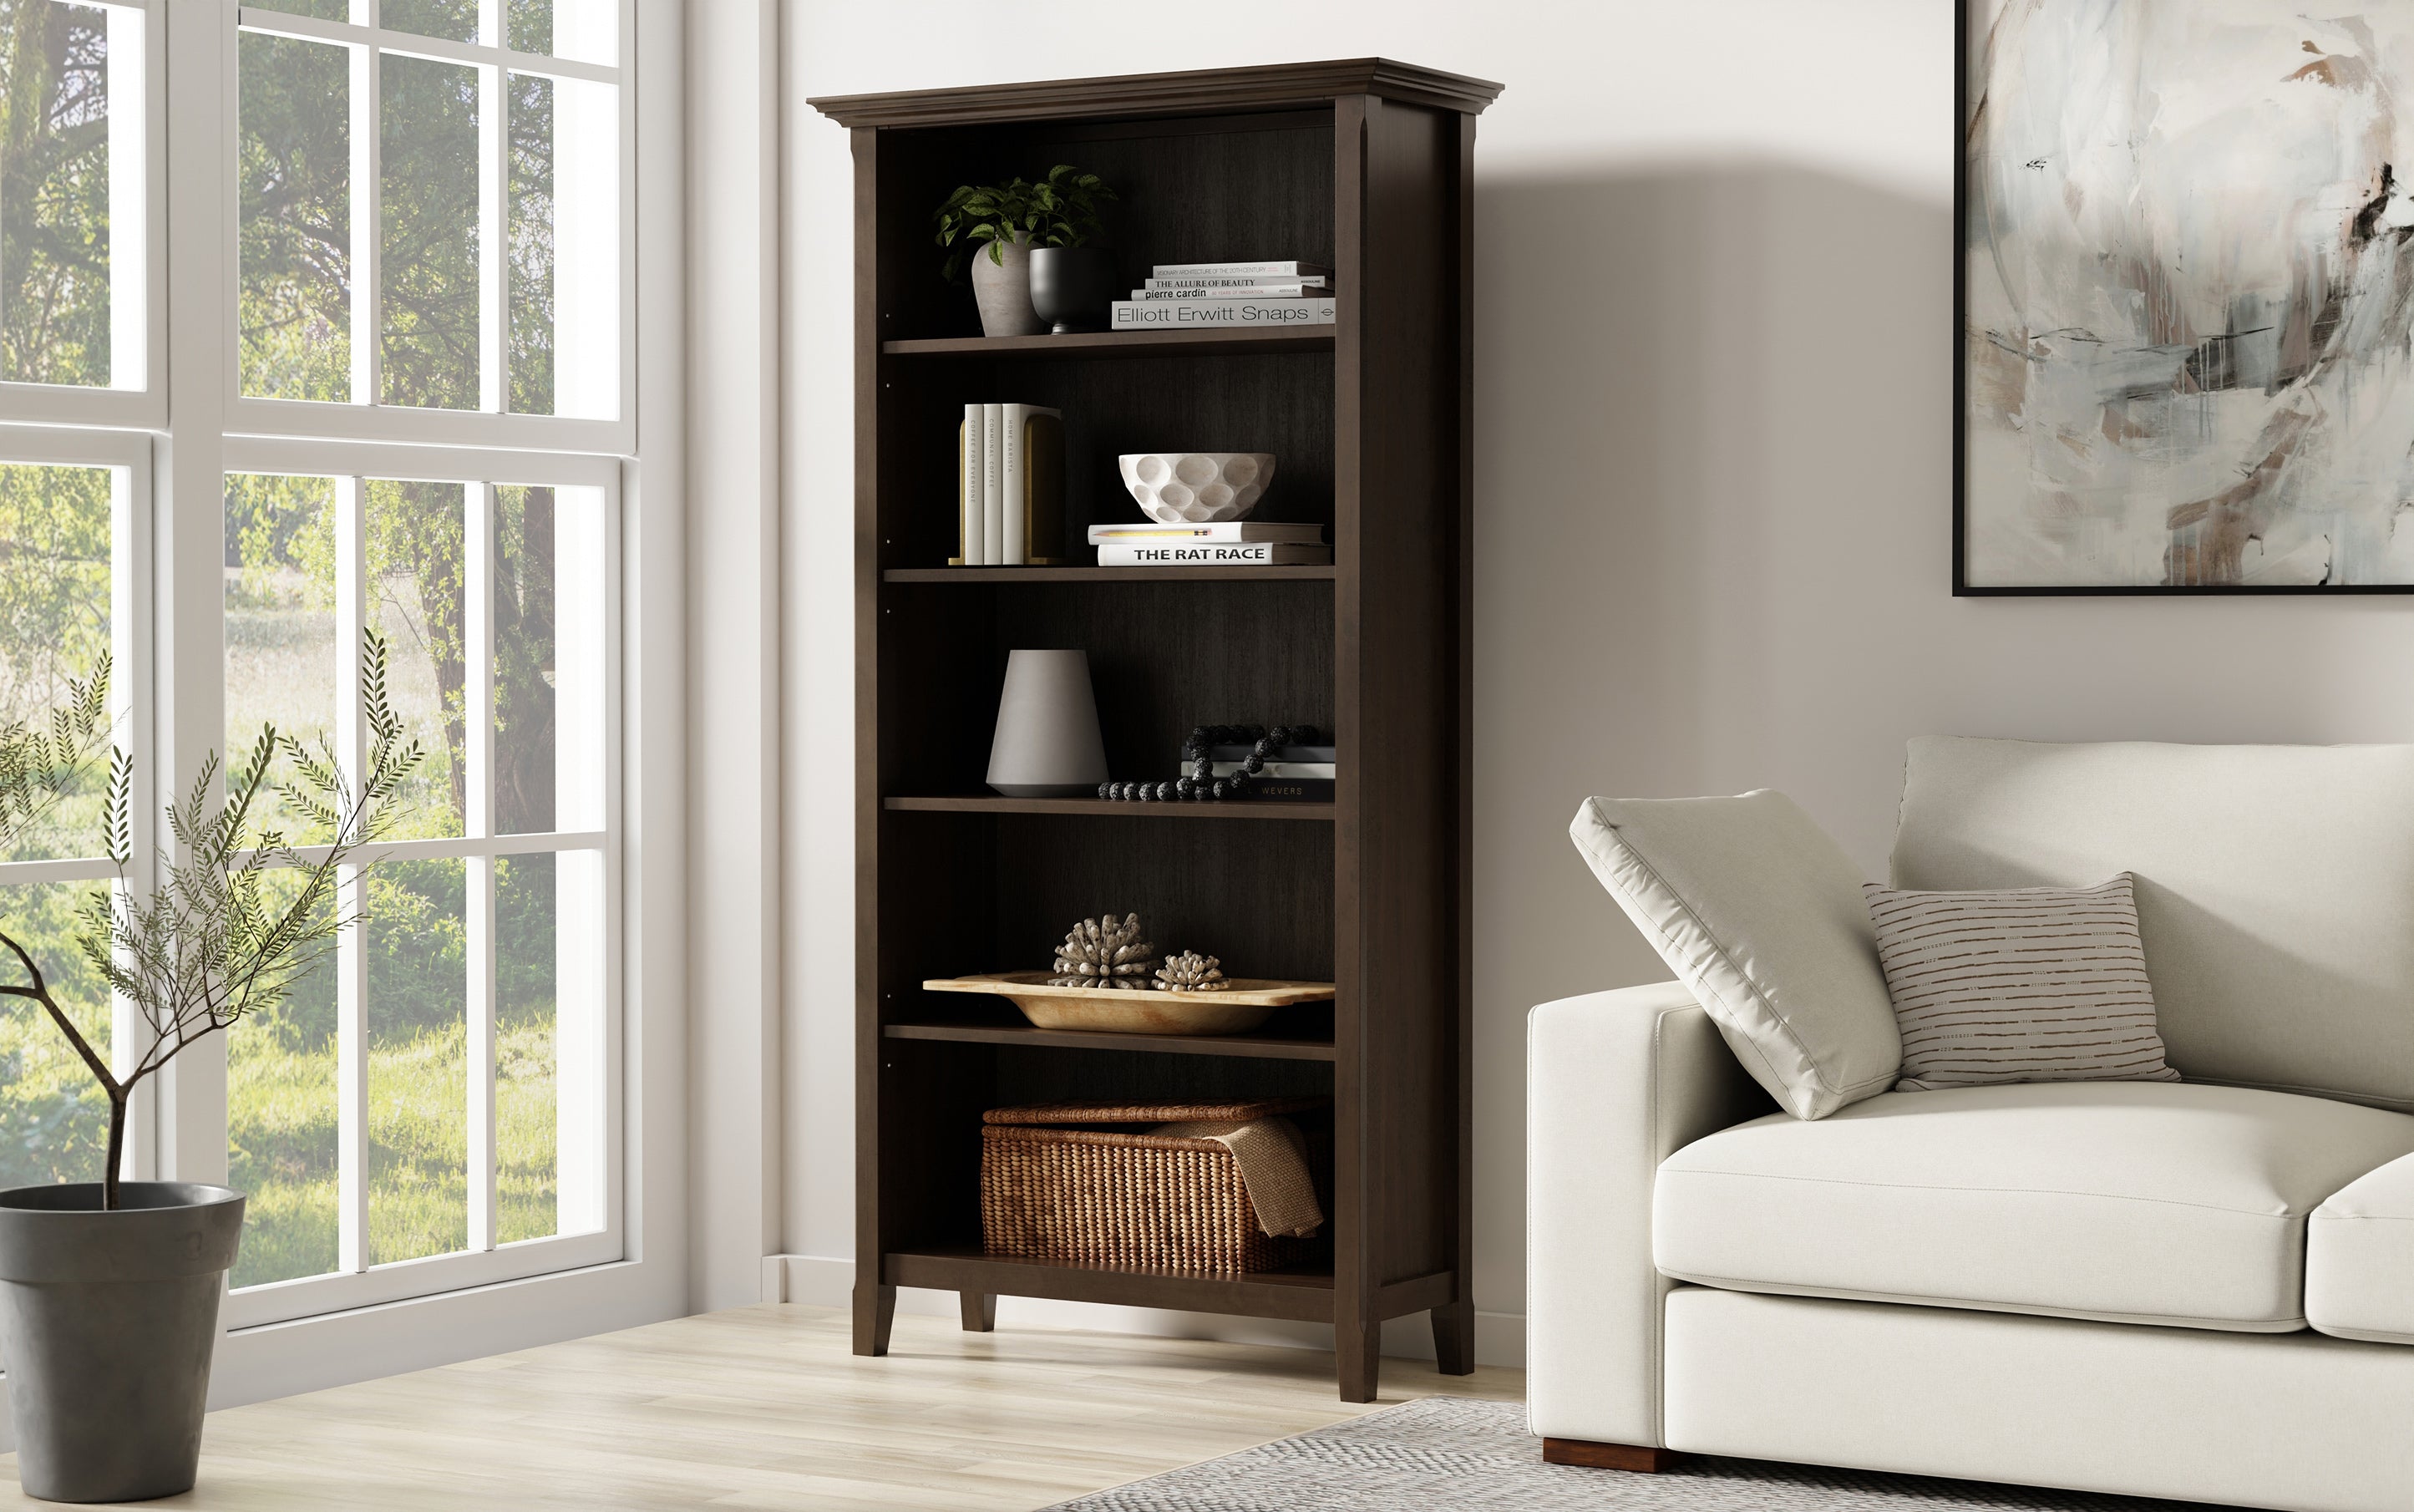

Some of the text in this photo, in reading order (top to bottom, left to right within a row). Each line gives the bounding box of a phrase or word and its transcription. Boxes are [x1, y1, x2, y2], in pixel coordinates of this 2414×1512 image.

[1145, 288, 1206, 300] pierre cardin
[1118, 306, 1309, 322] Elliott Erwitt Snaps
[1134, 548, 1265, 561] THE RAT RACE
[1261, 787, 1303, 795] WEVERS
